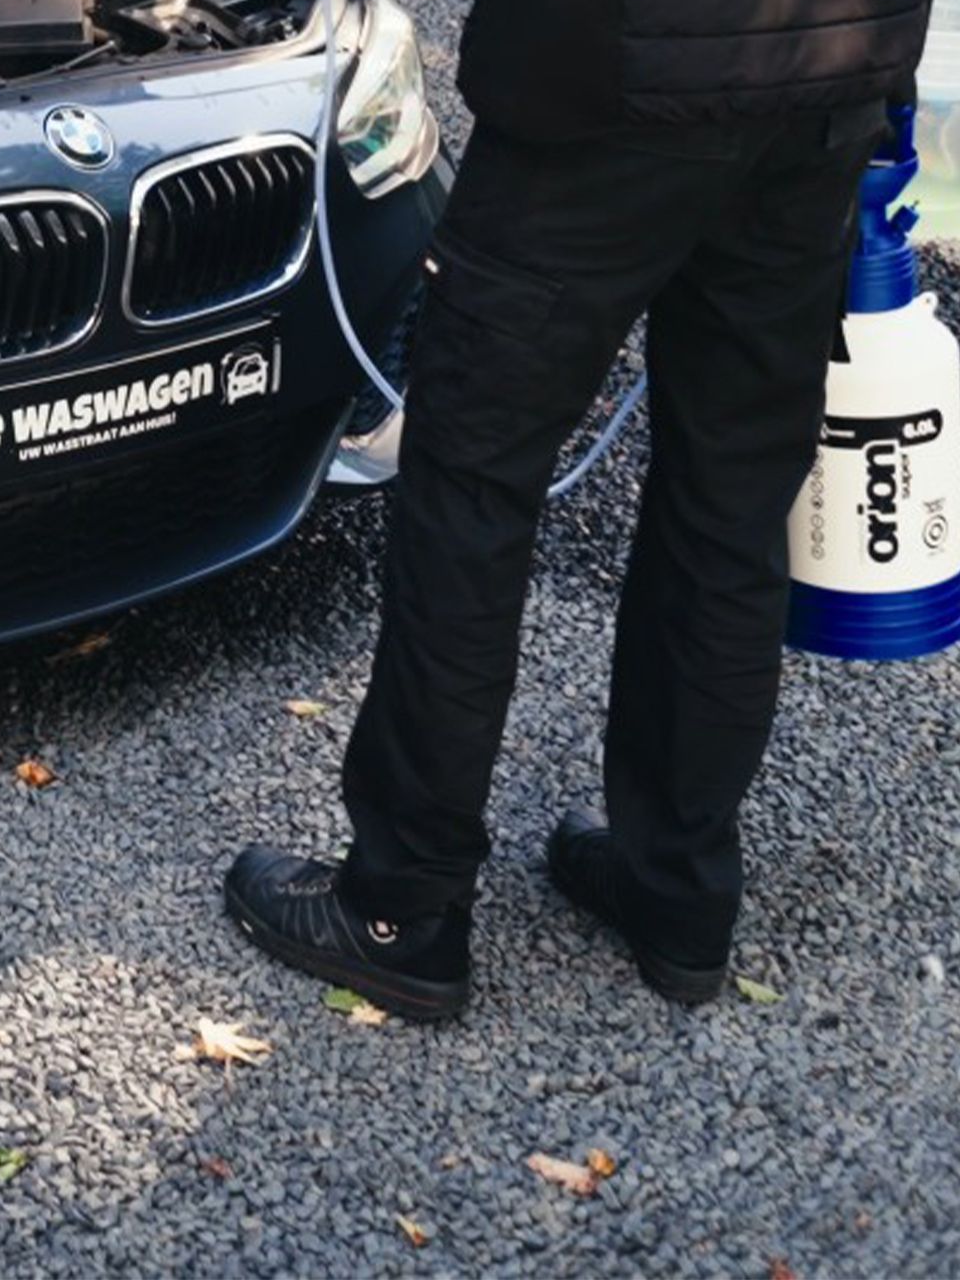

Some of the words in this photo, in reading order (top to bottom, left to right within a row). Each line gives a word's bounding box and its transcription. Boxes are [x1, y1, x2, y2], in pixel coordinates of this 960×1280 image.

[18, 448, 41, 461] UW
[43, 427, 118, 456] WASSTRAAT
[119, 422, 145, 440] AAN
[856, 443, 898, 564] orion
